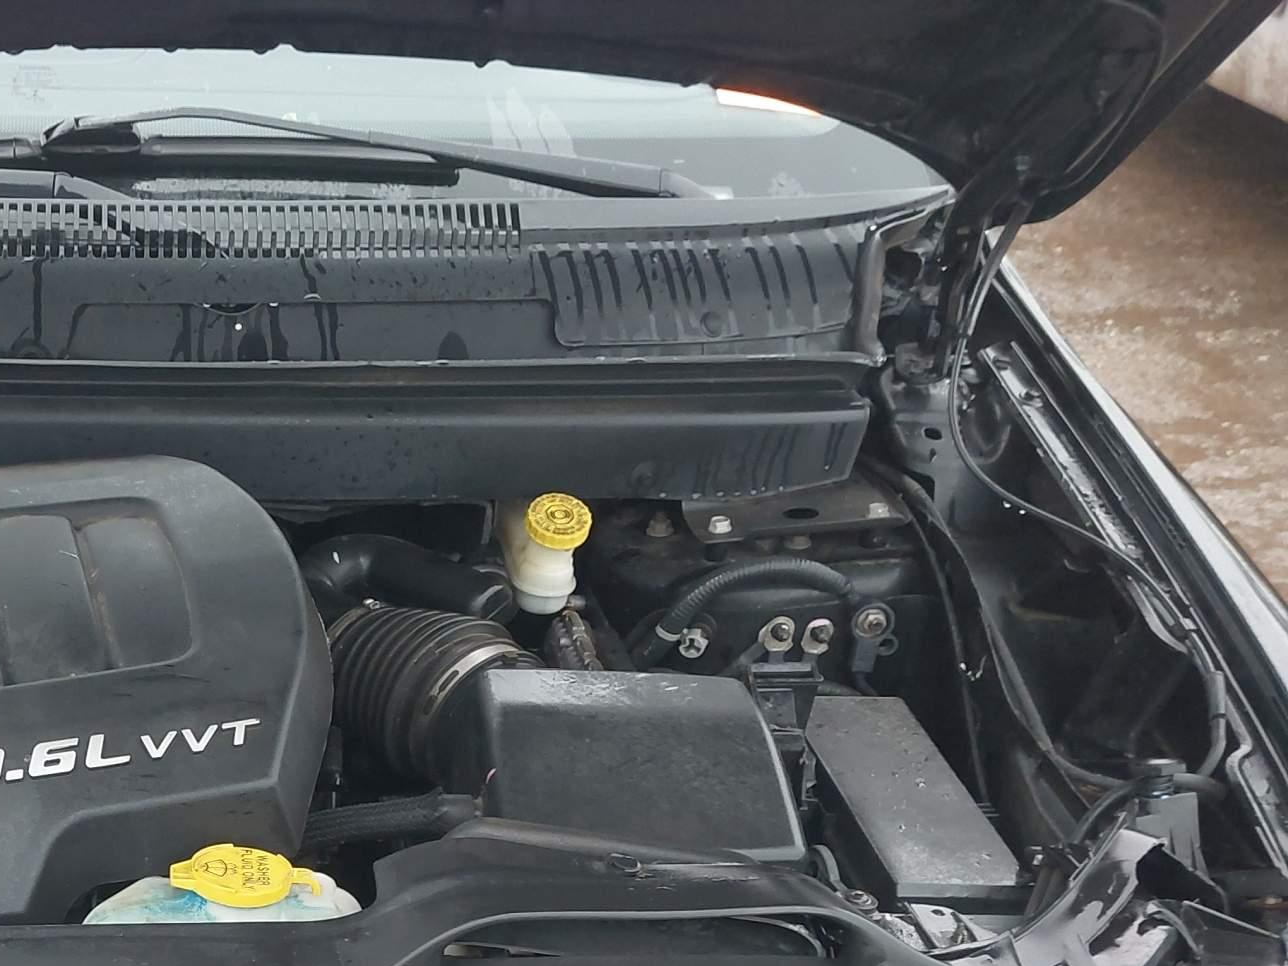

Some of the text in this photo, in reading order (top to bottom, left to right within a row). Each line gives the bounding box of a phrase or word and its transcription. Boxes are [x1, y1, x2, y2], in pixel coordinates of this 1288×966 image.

[140, 718, 261, 759] VVT
[241, 849, 256, 890] FLUID ONLY
[256, 855, 271, 886] WASHER
